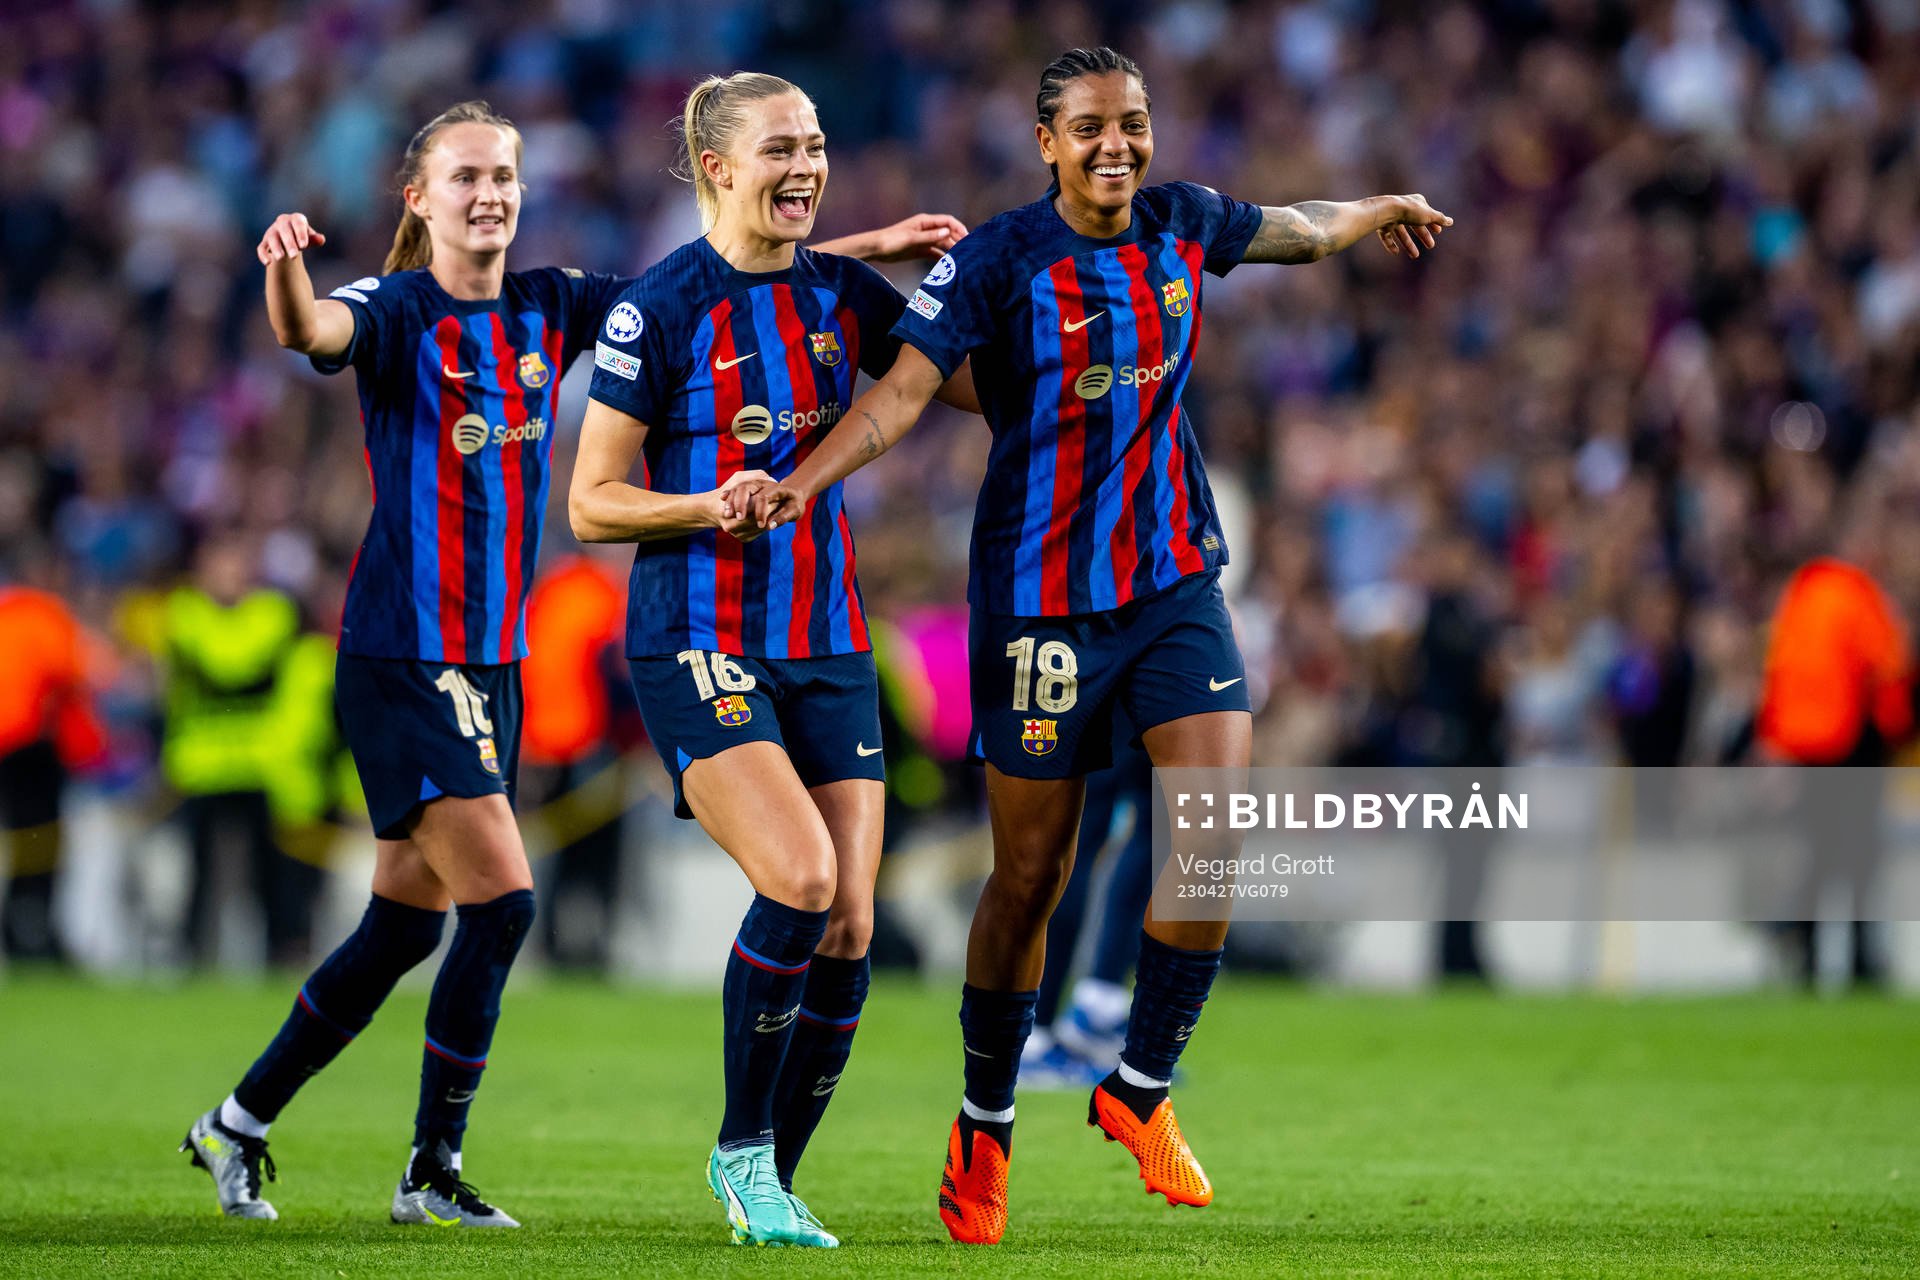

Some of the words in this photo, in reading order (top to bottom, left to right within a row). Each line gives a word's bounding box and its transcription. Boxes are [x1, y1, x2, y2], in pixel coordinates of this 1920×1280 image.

[491, 418, 548, 446] Spotify
[676, 649, 757, 702] 16
[1005, 636, 1079, 714] 18
